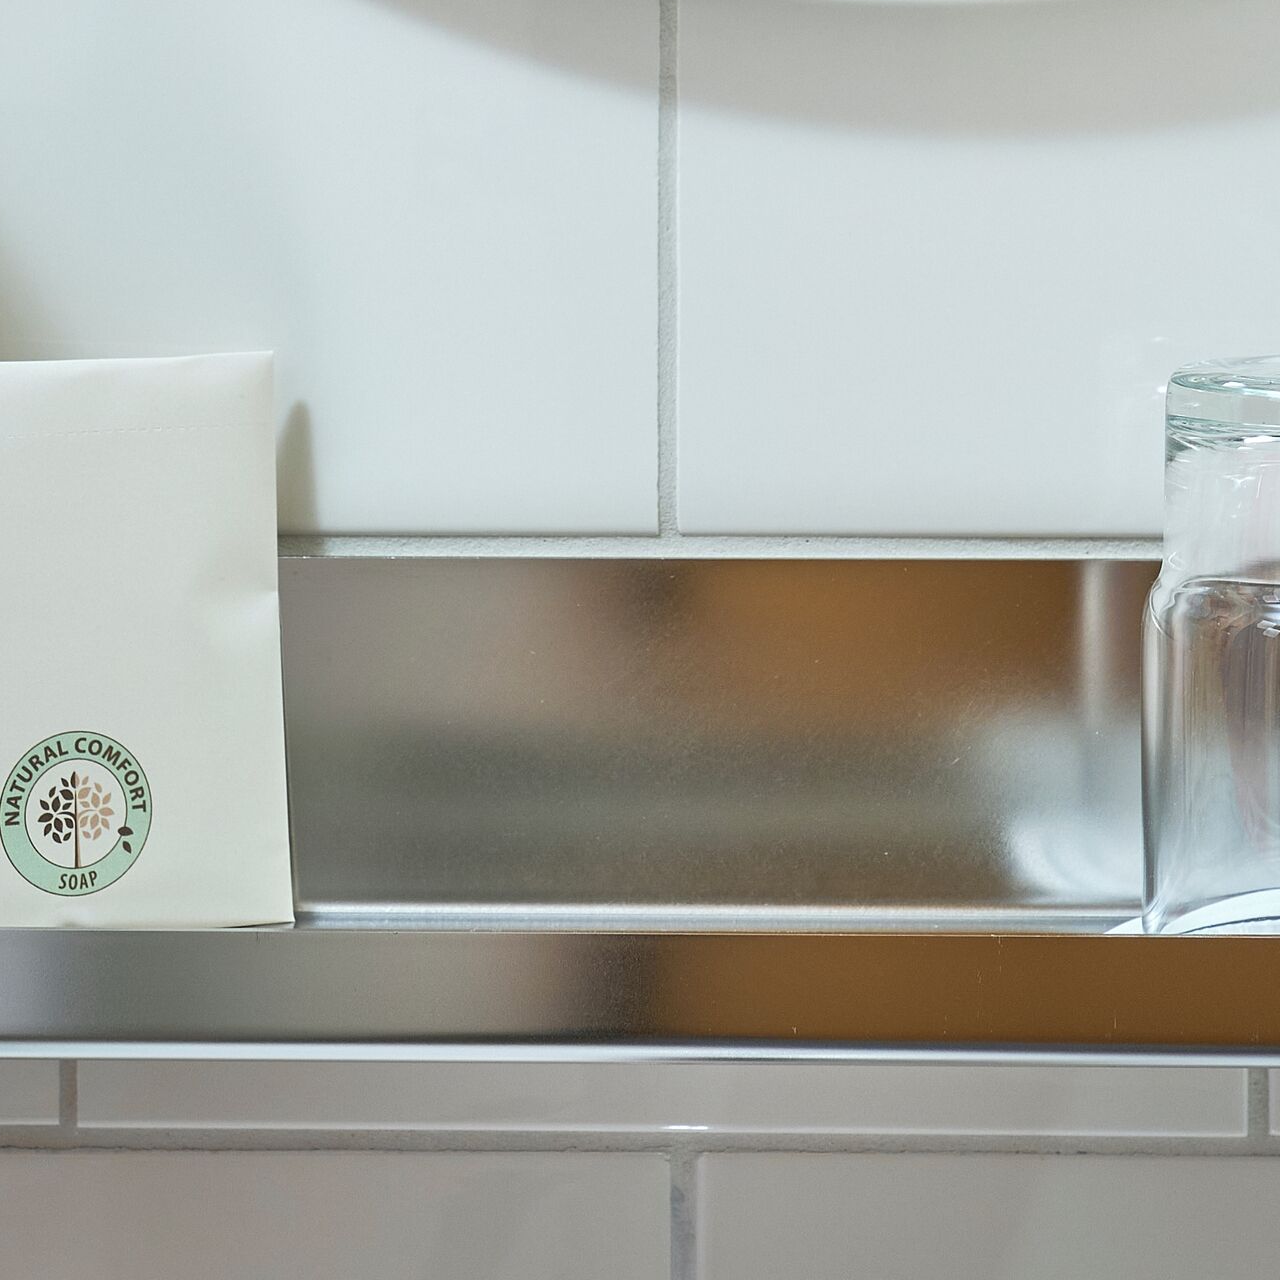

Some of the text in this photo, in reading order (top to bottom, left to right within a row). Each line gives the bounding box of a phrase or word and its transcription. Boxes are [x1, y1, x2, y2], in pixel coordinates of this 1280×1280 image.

[4, 737, 147, 827] NATURAL COMFORT
[58, 870, 98, 891] SOAP
